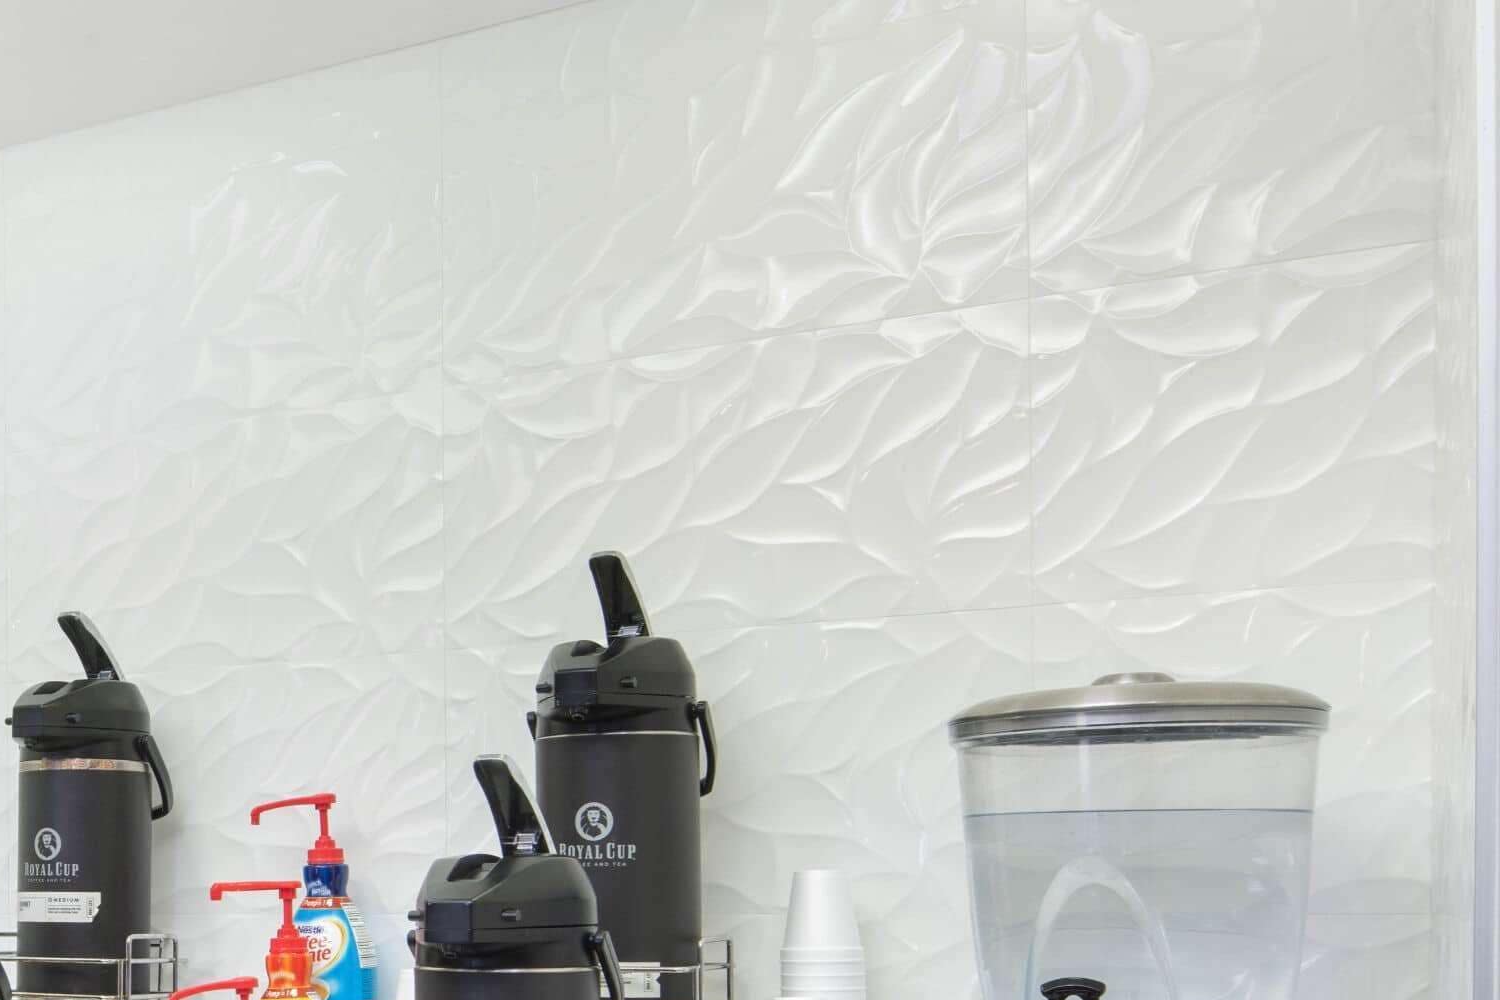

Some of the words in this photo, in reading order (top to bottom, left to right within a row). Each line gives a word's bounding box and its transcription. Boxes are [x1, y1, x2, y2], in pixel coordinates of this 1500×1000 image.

[559, 842, 603, 859] ROYAL
[606, 842, 636, 859] CUP
[24, 862, 53, 876] ROYAL
[55, 861, 79, 877] CUP
